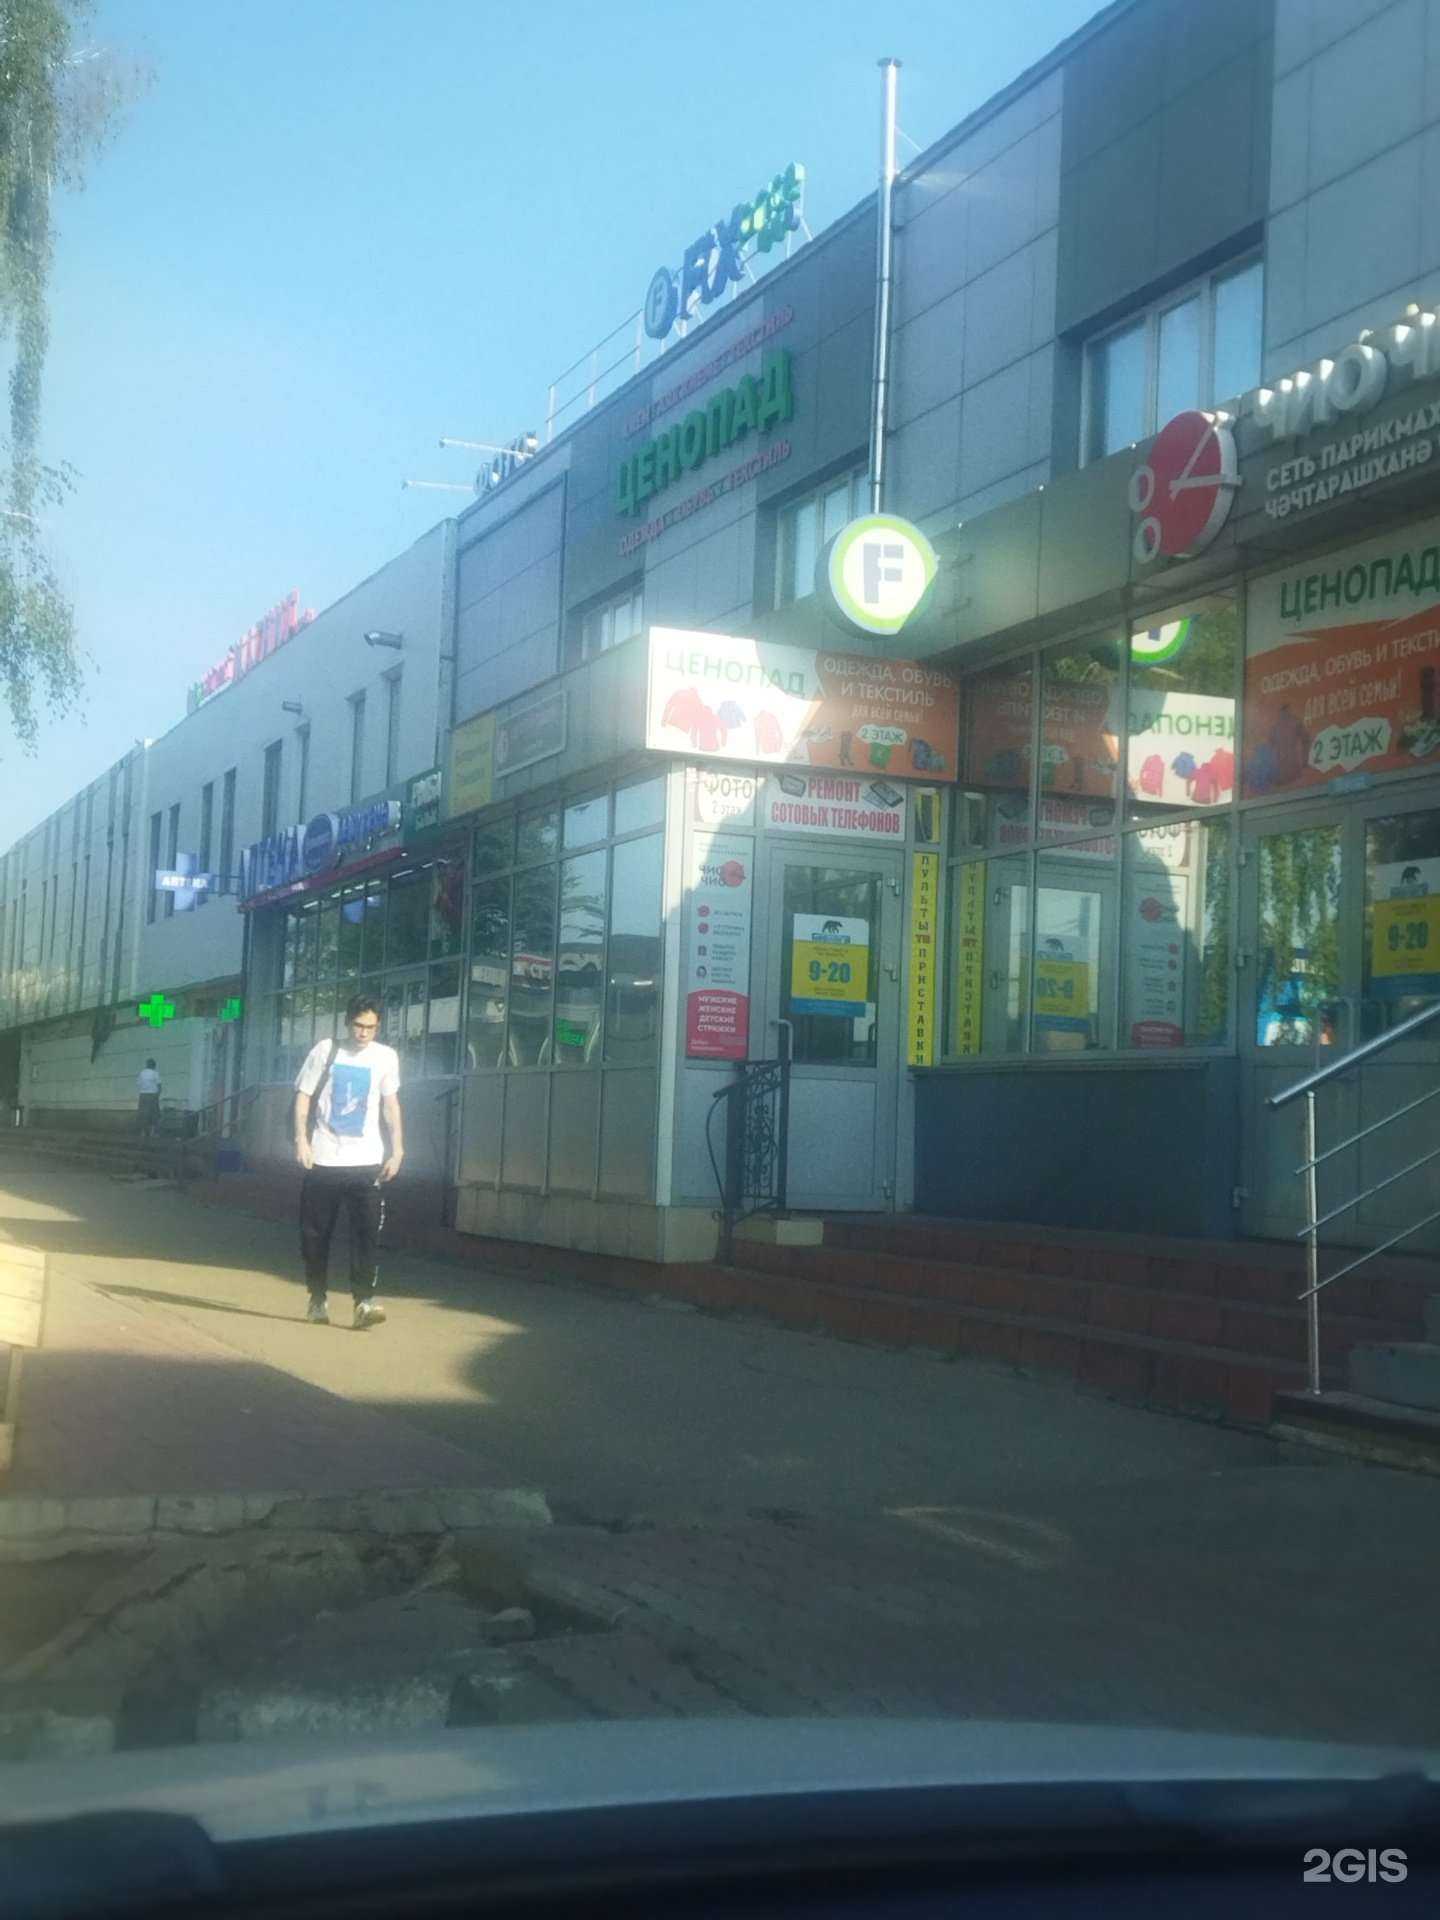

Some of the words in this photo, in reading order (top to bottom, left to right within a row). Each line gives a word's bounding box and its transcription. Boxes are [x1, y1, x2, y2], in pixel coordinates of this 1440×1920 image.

[615, 348, 794, 517] ЦЕНОПАД
[1266, 456, 1316, 491] СЕТЬ
[863, 542, 904, 604] F
[1279, 545, 1440, 622] ЦЕНОПАД
[665, 650, 806, 698] ЦЕНОПАД
[1324, 651, 1372, 677] ОБУВЬ
[1376, 642, 1389, 662] И
[841, 681, 853, 697] И
[857, 682, 935, 707] ТЕКСТИЛЬ
[902, 667, 953, 689] ОБУВЬ
[861, 727, 869, 739] 2
[871, 729, 904, 744] ЭТАЖ
[1313, 740, 1323, 764] 2
[1329, 726, 1384, 760] ЭТАЖ
[807, 776, 861, 802] РЕМОНТ
[771, 801, 828, 828] СОТОВЫХ
[831, 806, 901, 834] ТЕЛЕФОНОВ
[808, 959, 851, 984] 9-20
